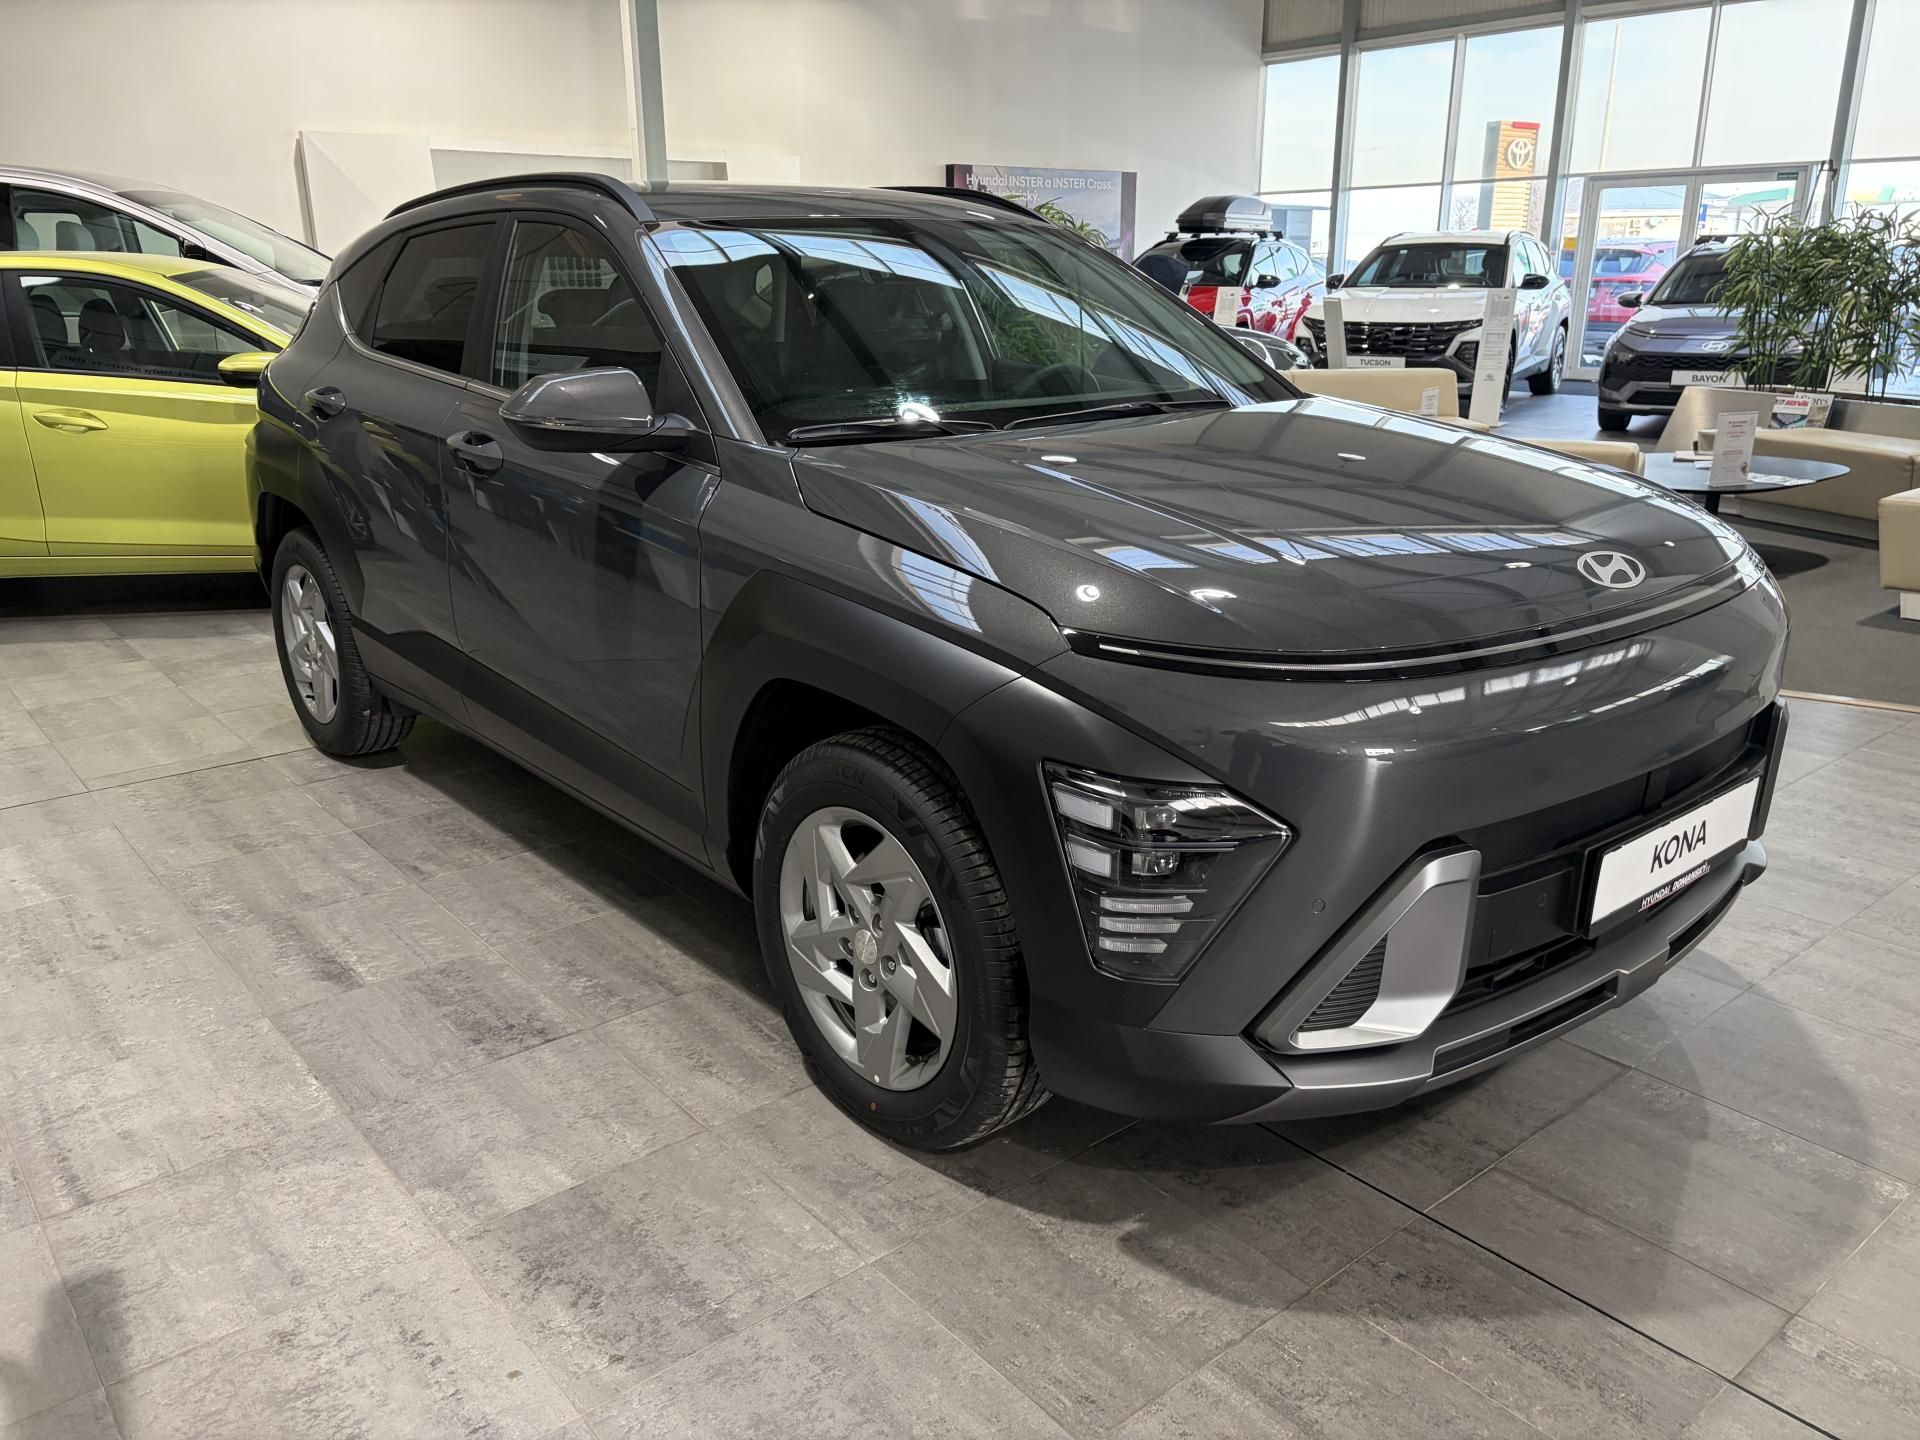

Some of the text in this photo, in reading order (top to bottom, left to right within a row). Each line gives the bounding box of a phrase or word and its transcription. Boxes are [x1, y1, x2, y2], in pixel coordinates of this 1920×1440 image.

[966, 173, 1008, 188] Hyundai
[1009, 176, 1043, 188] INSTER
[1053, 178, 1086, 189] INSTER
[1087, 178, 1114, 190] Cross.
[1360, 358, 1391, 366] TUCSON
[1691, 374, 1727, 384] BAYON
[1650, 819, 1706, 873] KONA
[1641, 884, 1671, 908] HYUNDAI
